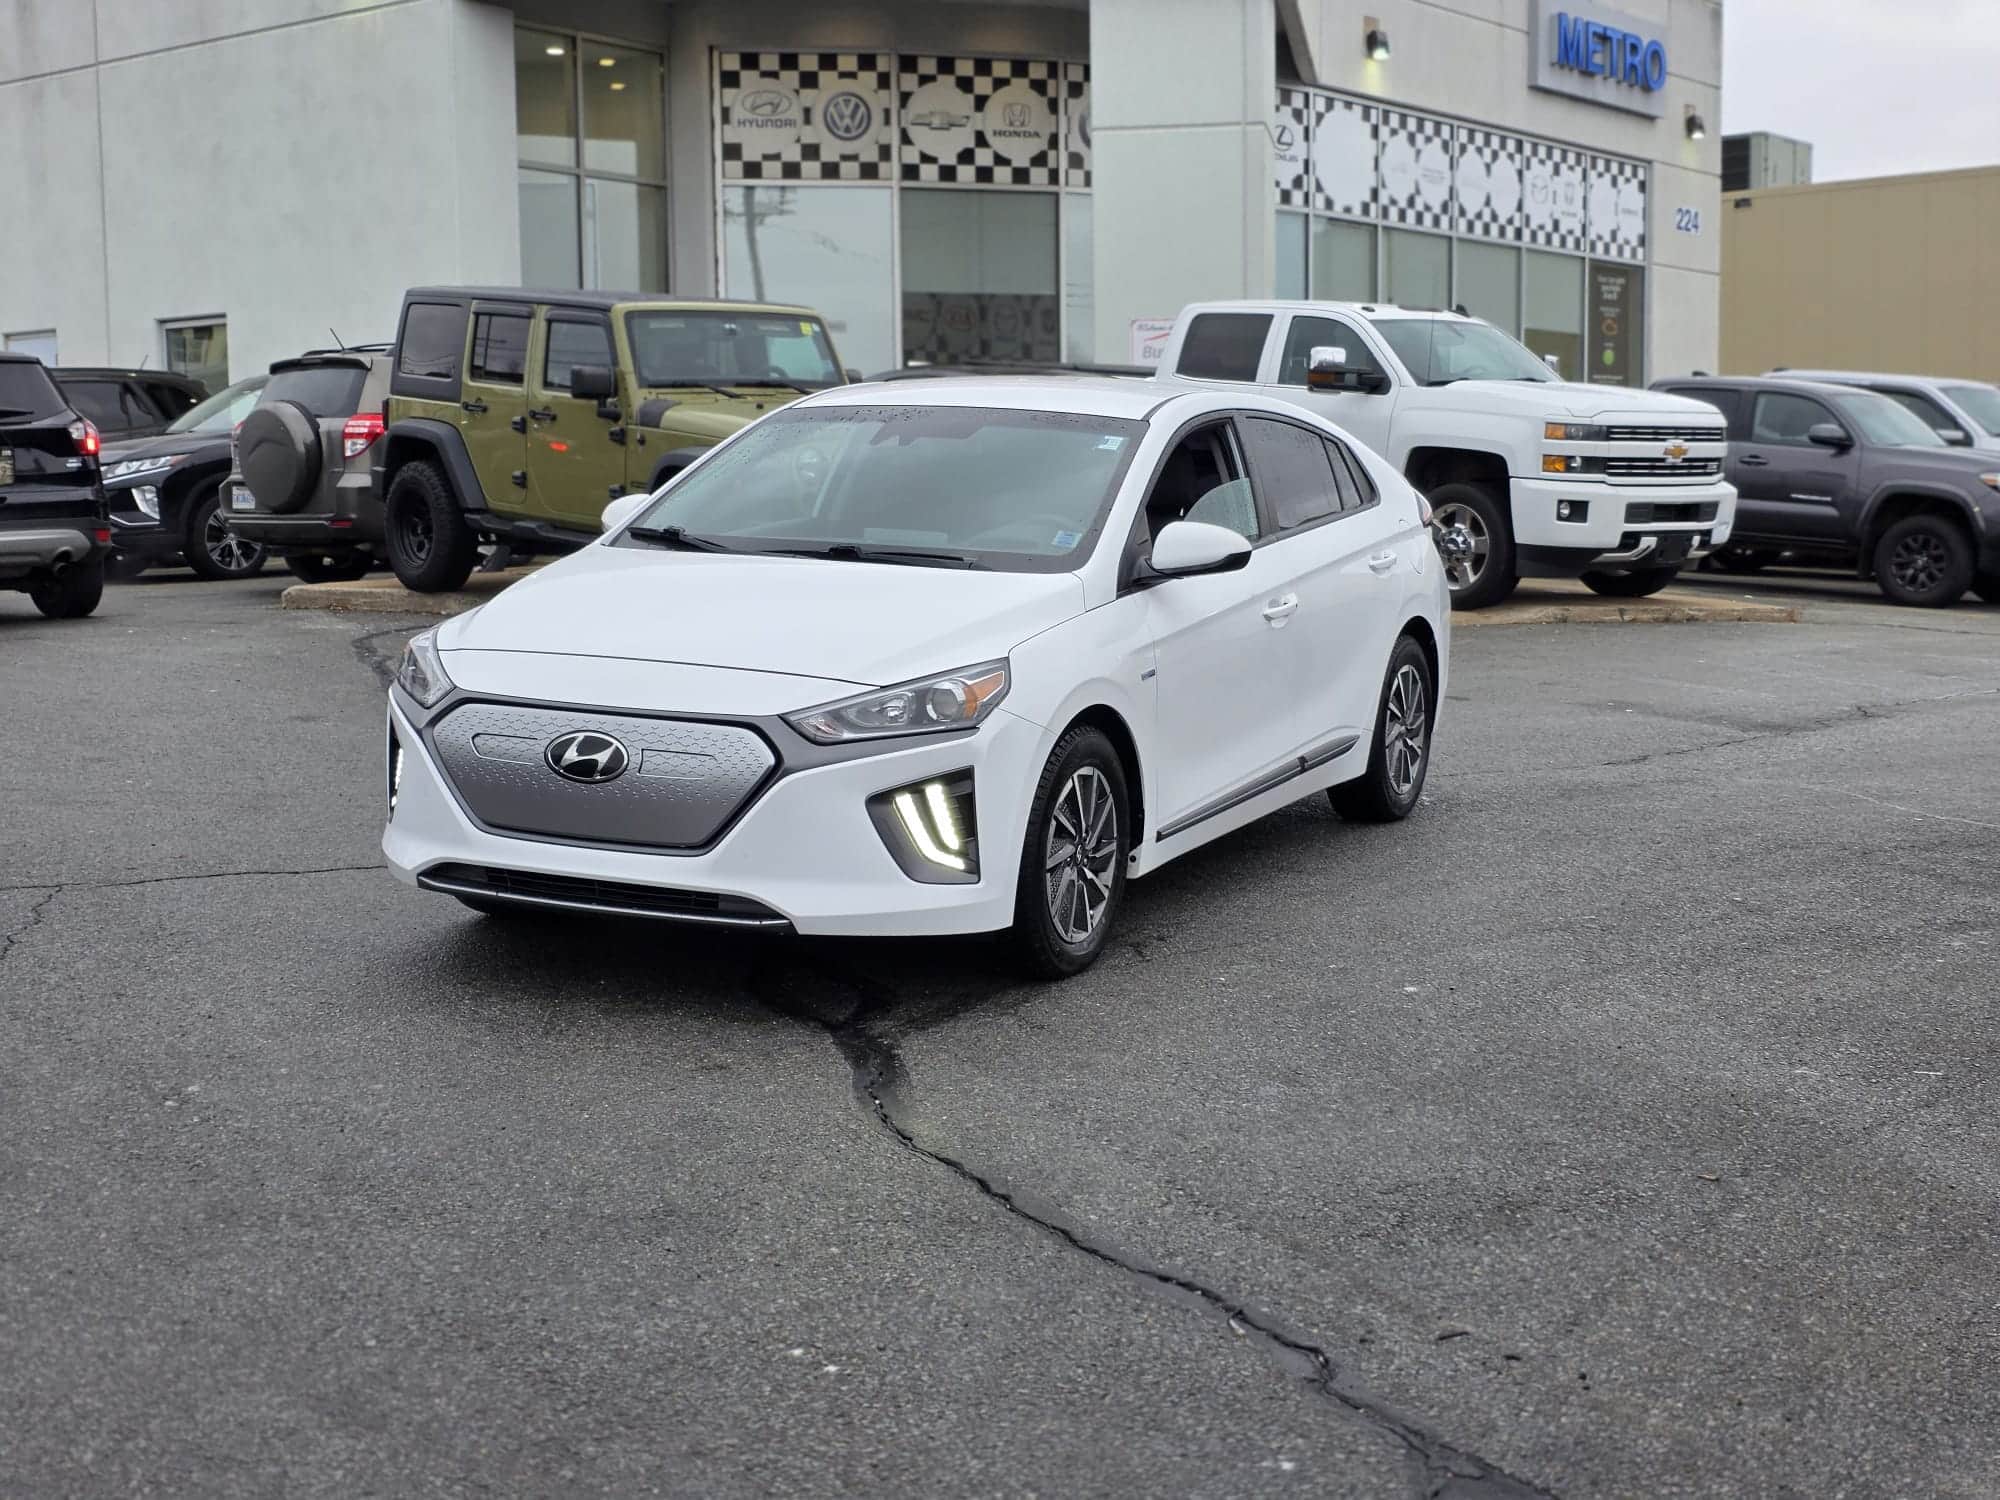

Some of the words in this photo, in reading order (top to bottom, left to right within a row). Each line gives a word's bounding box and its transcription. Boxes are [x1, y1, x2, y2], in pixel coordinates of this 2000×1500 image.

[1557, 11, 1666, 92] METRO
[737, 118, 797, 129] HYUNDAI
[992, 129, 1041, 138] HONDA
[1676, 207, 1699, 233] 224
